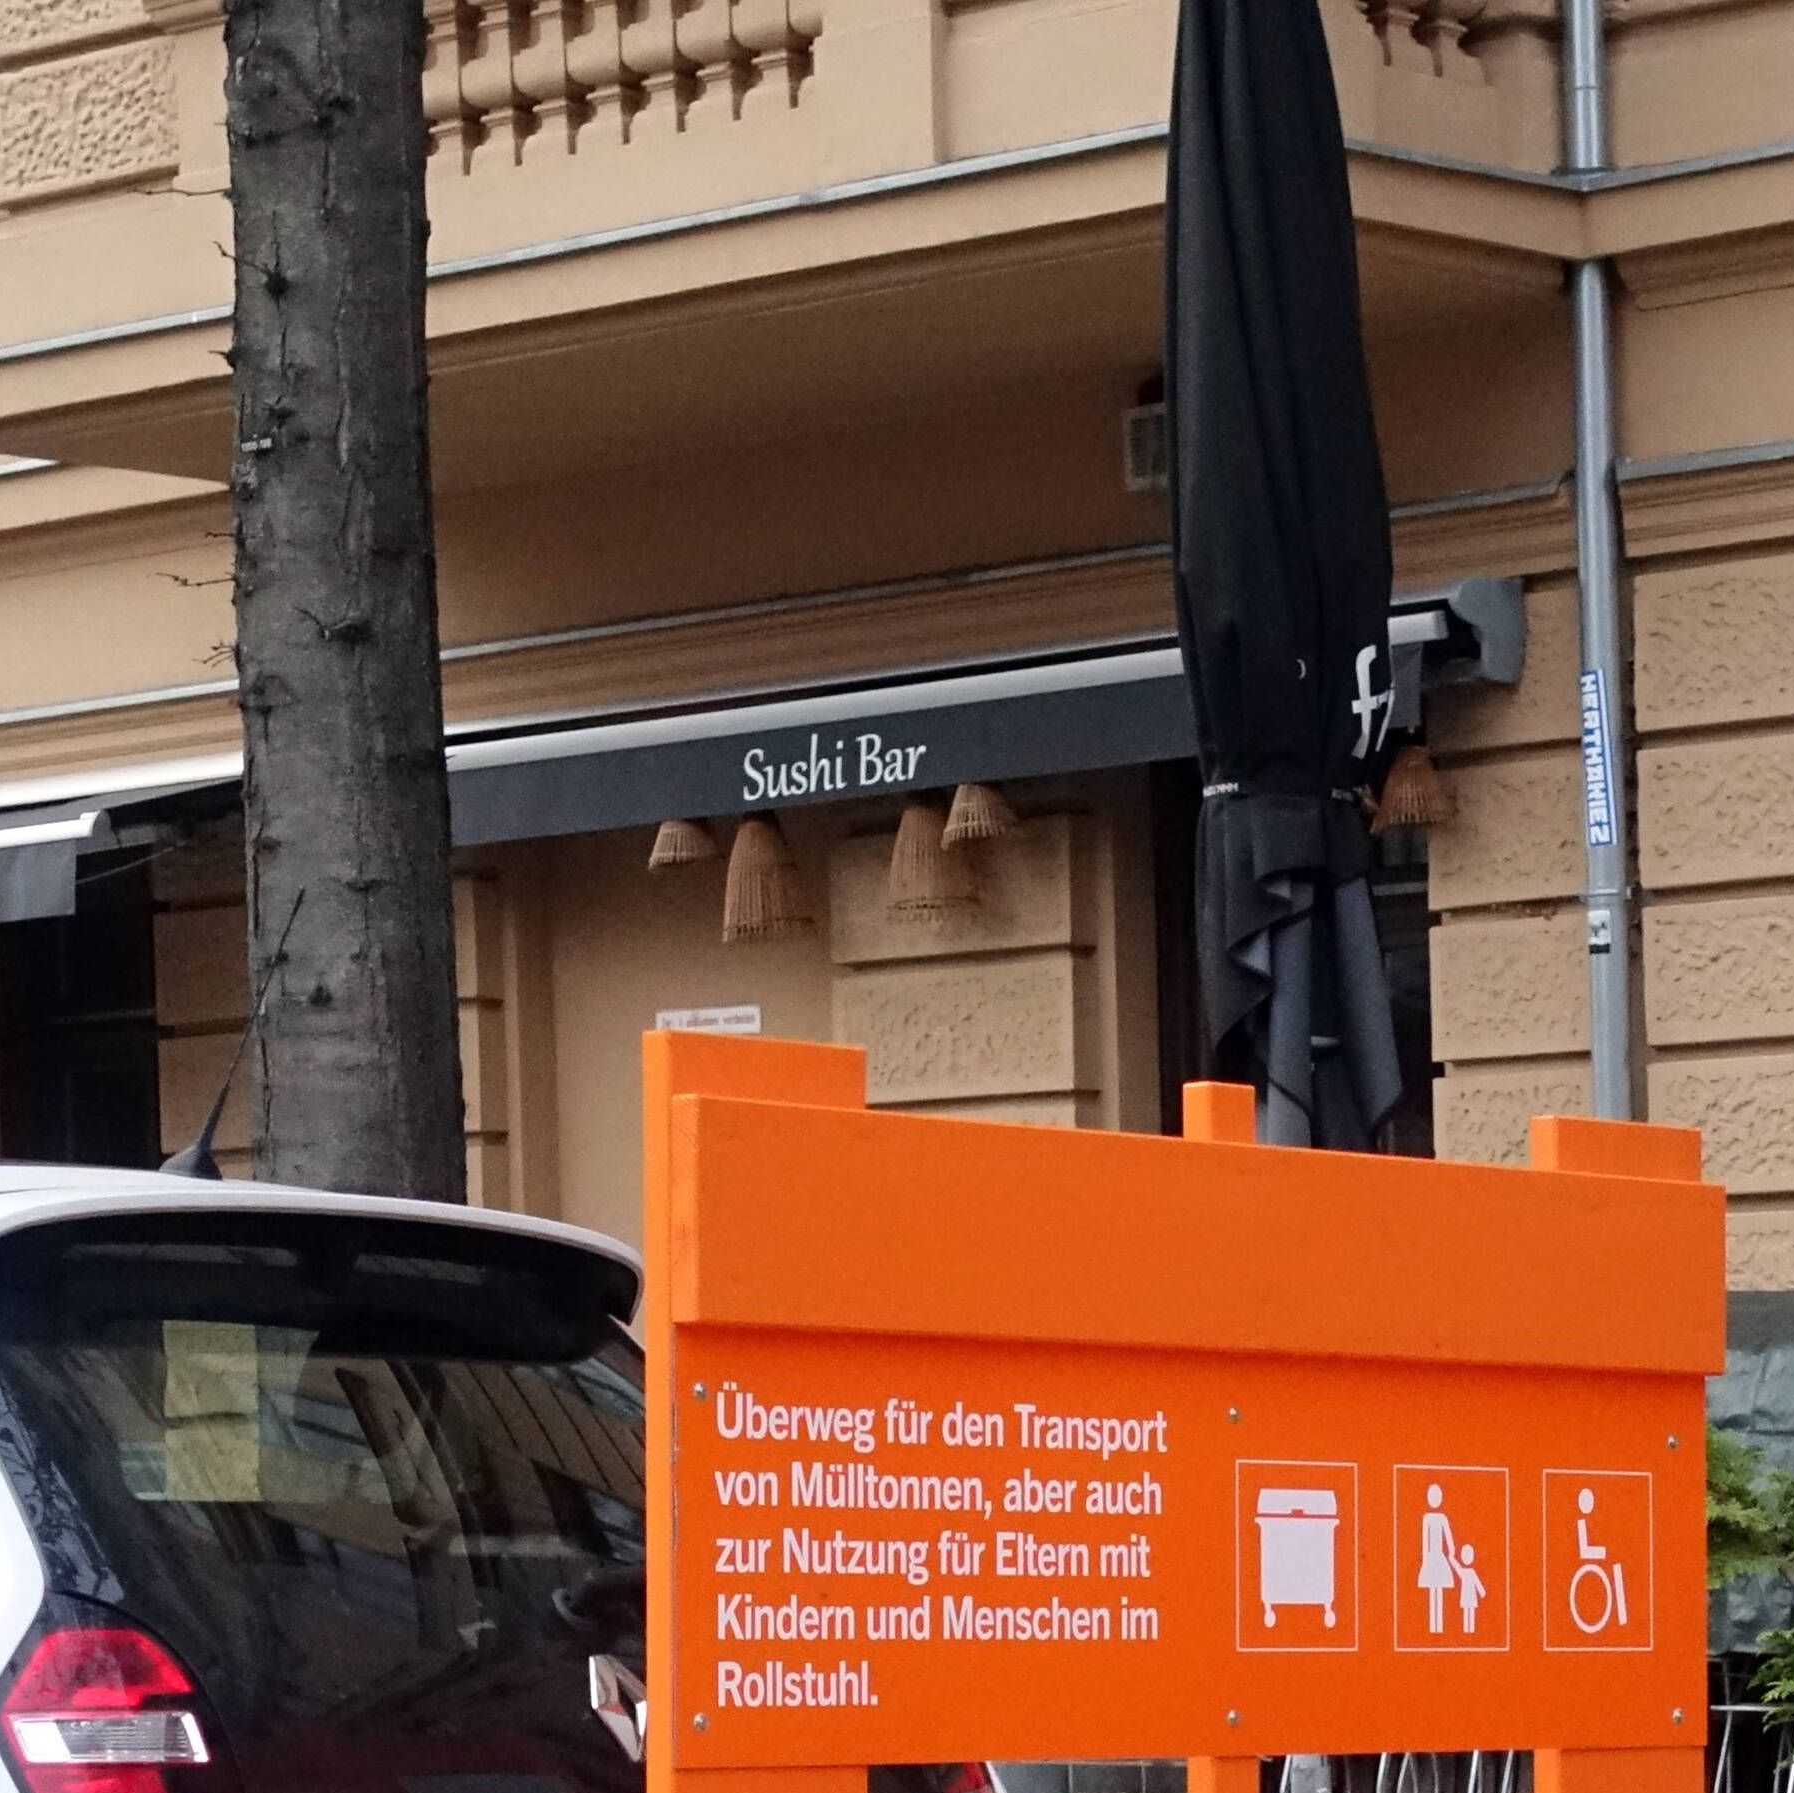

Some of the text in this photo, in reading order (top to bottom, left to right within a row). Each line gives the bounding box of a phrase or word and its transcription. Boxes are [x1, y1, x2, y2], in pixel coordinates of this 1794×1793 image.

[743, 733, 927, 801] Sushi Bar
[716, 1381, 1168, 1461] Überweg für den Transport
[714, 1461, 1162, 1520] von Mülltonnen, aber auch
[715, 1527, 1151, 1586] zur Nutzung für Eltern mit
[717, 1593, 1159, 1641] Kindern und Menschen im
[717, 1660, 879, 1708] Rollstuhl.
